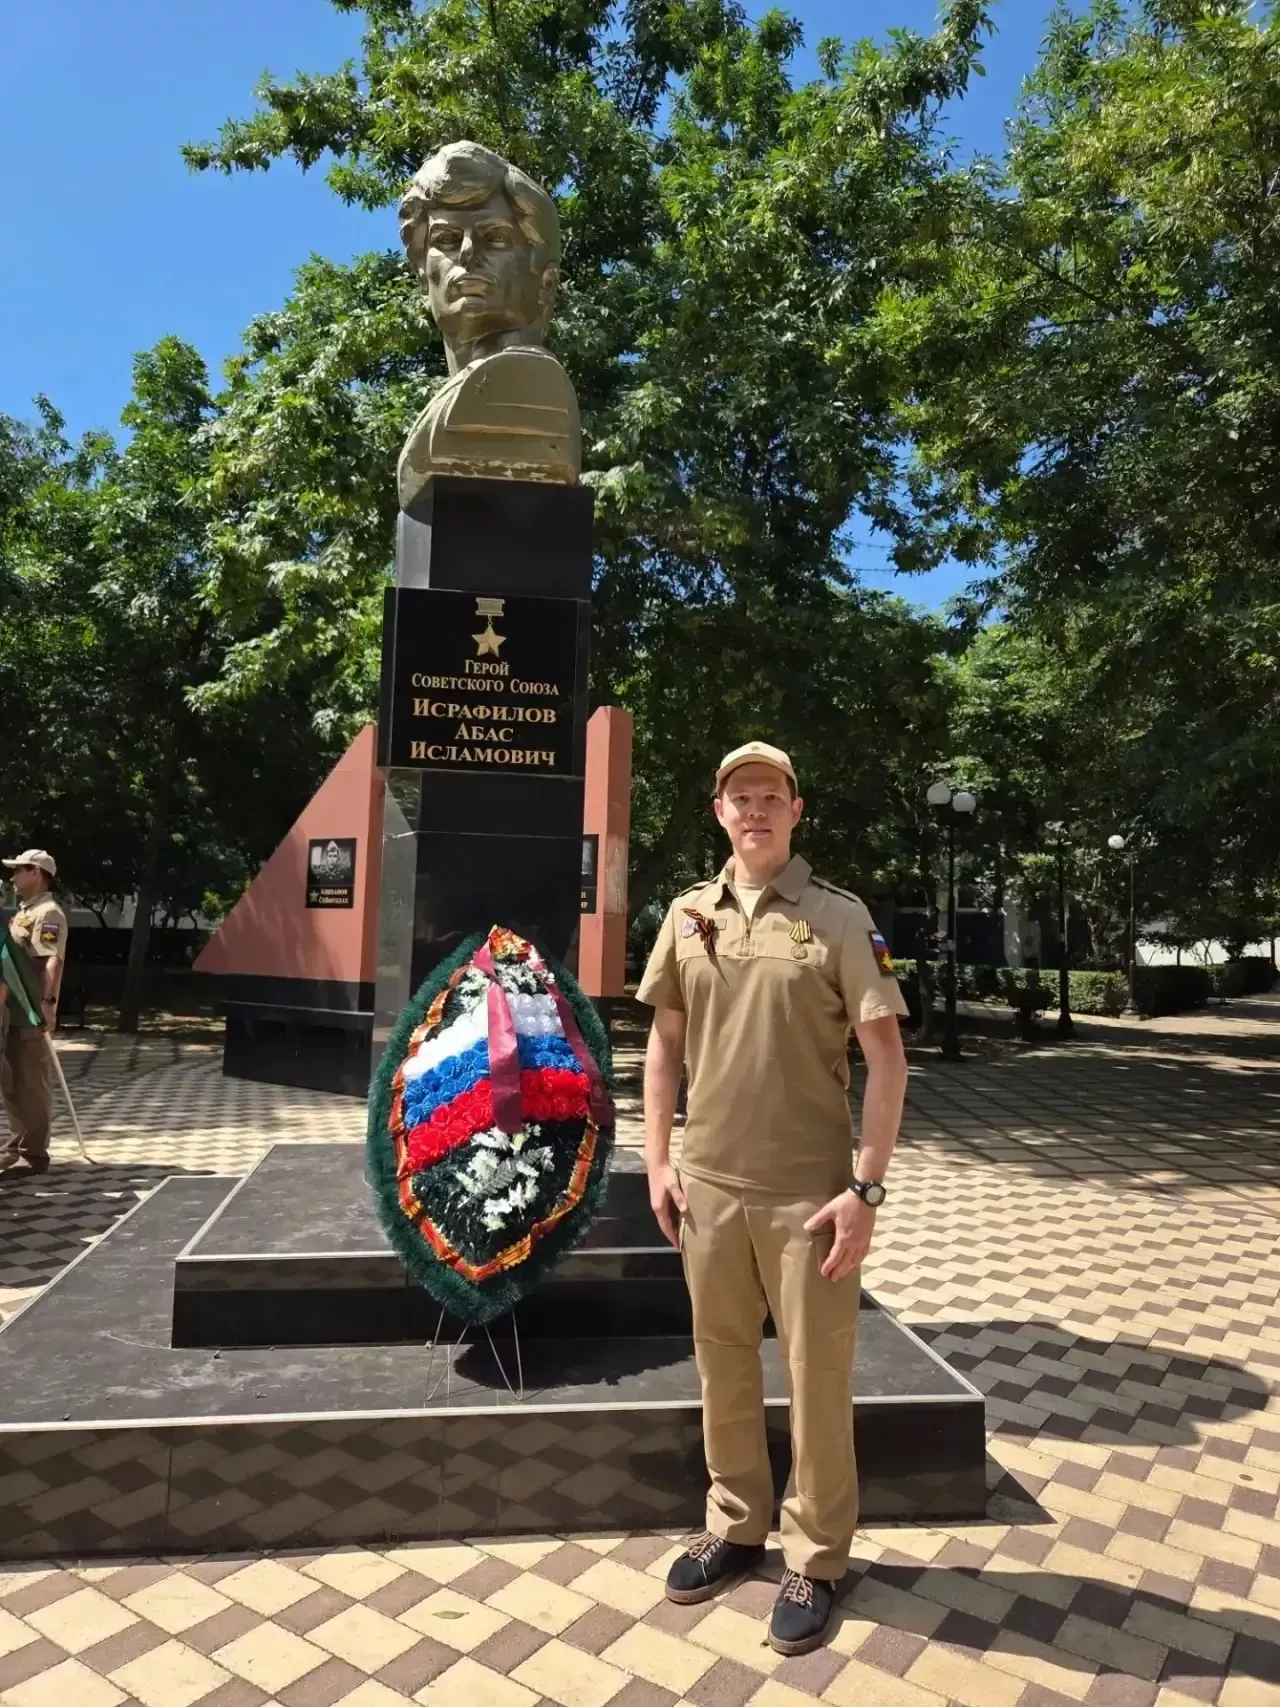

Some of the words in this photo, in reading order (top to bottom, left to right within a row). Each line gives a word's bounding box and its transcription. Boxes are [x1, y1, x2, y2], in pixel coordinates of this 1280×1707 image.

[465, 660, 510, 676] ГЕРОЙ
[412, 673, 504, 692] СОВЕТСКОГО
[510, 679, 559, 696] СОЮЗА
[413, 698, 557, 722] ИСРАФИЛОВ
[454, 722, 514, 742] АБАС
[410, 741, 556, 766] ИСЛАМОВИЧ
